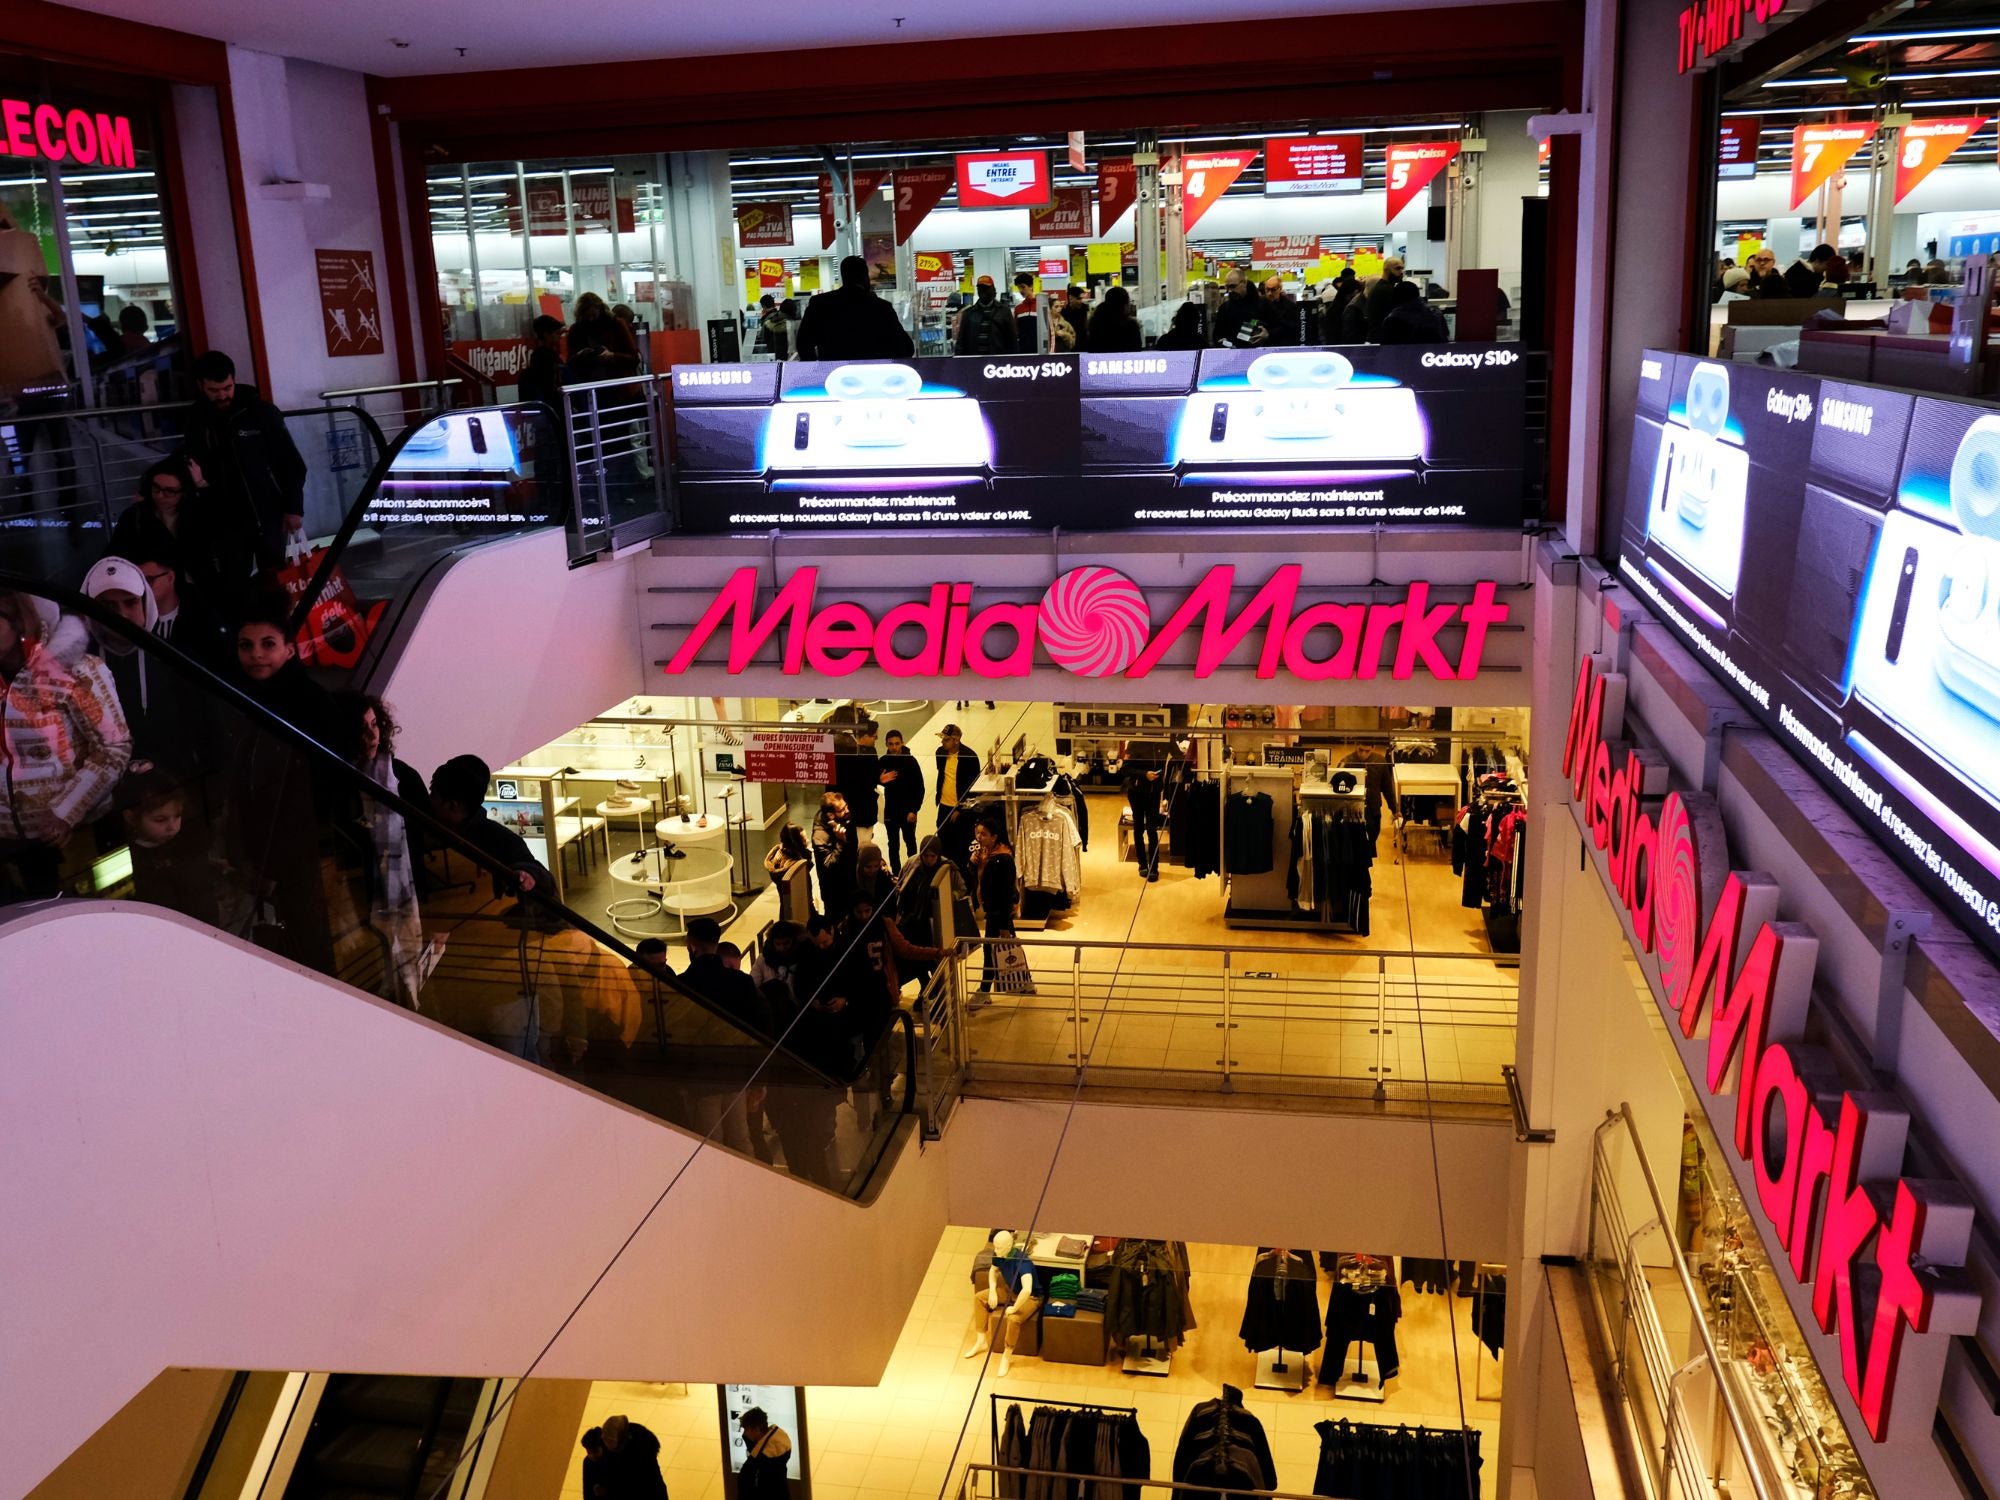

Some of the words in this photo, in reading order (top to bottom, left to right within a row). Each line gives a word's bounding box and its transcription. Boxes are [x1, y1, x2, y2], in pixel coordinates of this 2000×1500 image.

[1801, 144, 1824, 172] 7
[1902, 139, 1926, 169] 8
[1391, 163, 1411, 190] 5
[1102, 177, 1119, 202] 3
[1186, 172, 1206, 198] 4
[572, 187, 609, 201] NLINE
[900, 187, 913, 210] 2
[1053, 210, 1080, 222] BTW
[766, 222, 784, 231] TVA
[1088, 359, 1167, 375] SAMSUNG
[1421, 352, 1481, 369] Galaxy
[1484, 351, 1519, 366] S10+
[679, 371, 752, 386] SAMSUNG
[984, 364, 1038, 381] Galaxy
[1041, 362, 1072, 377] S10+
[1766, 387, 1797, 424] Galaxy
[1821, 397, 1874, 437] SAMSUNG
[799, 497, 889, 508] Précommandez
[890, 495, 956, 507] maintenant
[1212, 491, 1311, 503] Précommandez
[1312, 490, 1384, 502] maintenant
[795, 514, 837, 523] nouveau
[838, 513, 872, 524] Galaxy
[873, 512, 896, 522] Buds
[898, 512, 921, 522] sans
[1207, 508, 1252, 518] nouveau
[1253, 508, 1291, 520] Galaxy
[1292, 507, 1318, 518] Buds
[1319, 507, 1345, 517] sans
[664, 567, 1041, 678] Media
[1124, 564, 1510, 680] Markt
[753, 734, 778, 742] HEURES
[779, 734, 824, 743] D'OUVERTURE
[763, 743, 815, 751] OPENINGSUREN
[814, 762, 828, 770] 20h
[1269, 755, 1304, 763] TRAININ
[815, 771, 828, 779] 19h
[1779, 703, 1834, 771] Précommandez
[1833, 763, 1884, 817] maintenant
[1940, 862, 1987, 917] nouveau
[1030, 829, 1059, 840] addas
[1563, 653, 1660, 954] Media
[1680, 871, 1933, 1444] Markt
